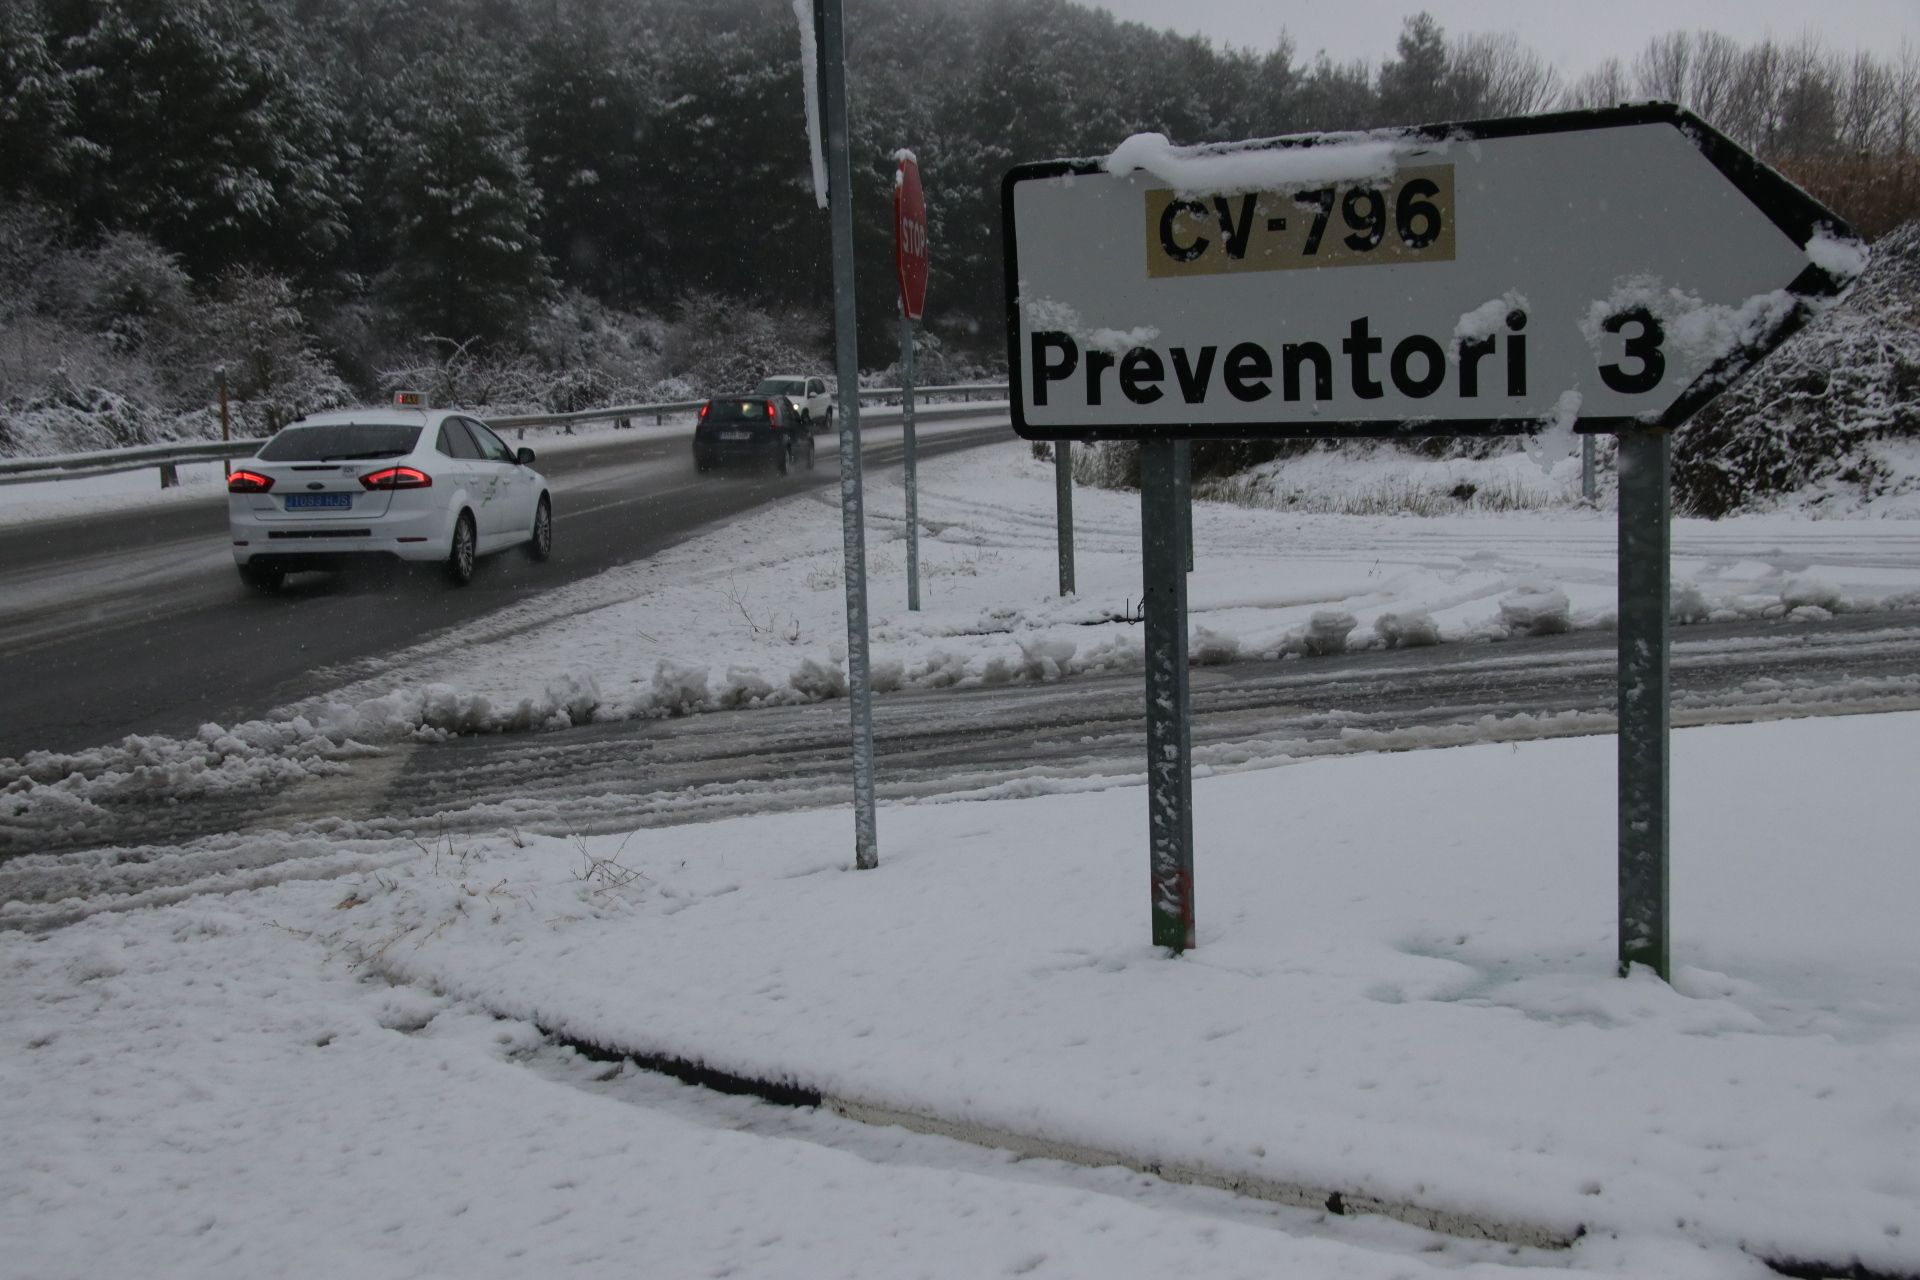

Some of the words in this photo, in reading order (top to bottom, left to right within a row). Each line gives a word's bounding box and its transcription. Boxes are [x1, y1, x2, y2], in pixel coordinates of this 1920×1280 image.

[902, 216, 926, 257] STOP
[1159, 178, 1442, 262] CV-796
[1031, 309, 1528, 406] Preventori
[1598, 304, 1666, 395] 3
